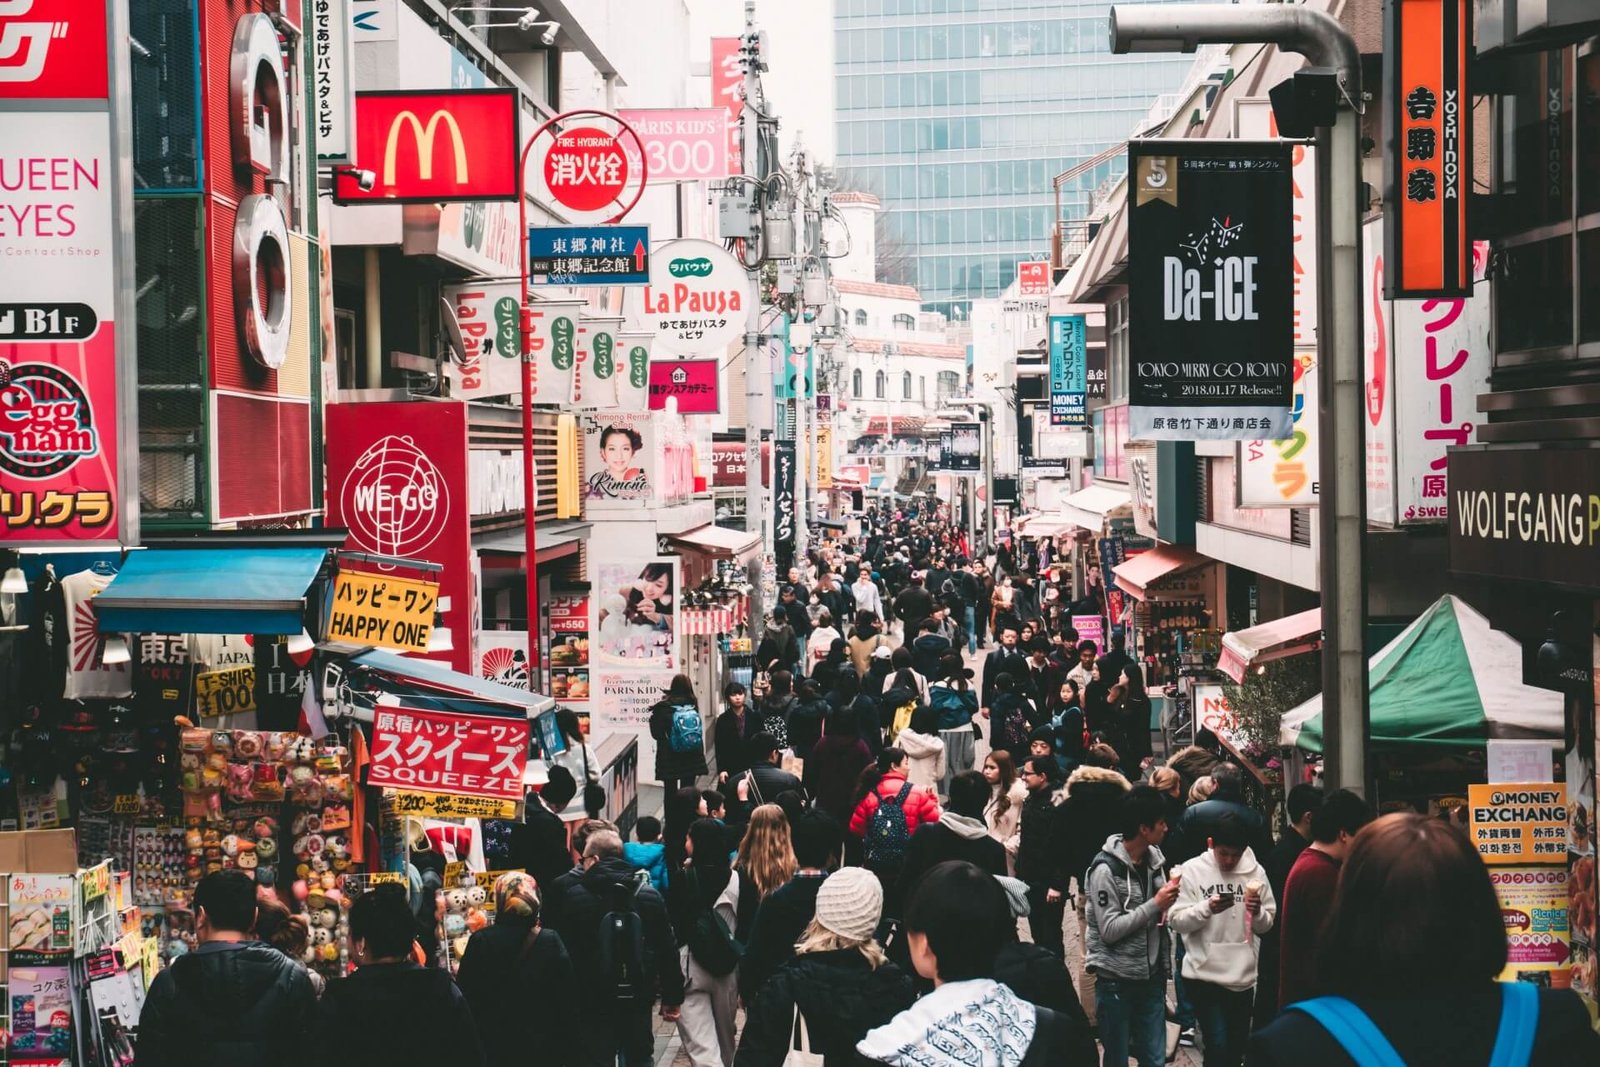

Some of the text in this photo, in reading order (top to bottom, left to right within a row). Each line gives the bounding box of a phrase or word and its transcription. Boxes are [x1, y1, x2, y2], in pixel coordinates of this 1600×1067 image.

[557, 137, 613, 148] FIRE HYDRANT
[1444, 90, 1457, 198] YOSHINOYA
[551, 152, 622, 186] 消火栓
[551, 237, 626, 254] 東郷神社
[551, 257, 630, 274] 東郷記念館
[643, 282, 741, 316] La Pausa
[1087, 369, 1107, 380] 品企
[1181, 384, 1237, 396] 2018.01.17
[1052, 394, 1085, 406] MONEY
[1052, 406, 1085, 414] EXCHANGE
[1152, 417, 1272, 430] 原宿竹下通り商店会
[1456, 489, 1583, 546] WOLFGANG
[337, 582, 434, 615] ハッピーワン
[330, 611, 429, 647] HAPPY ONE
[604, 686, 635, 695] PARIS
[376, 712, 527, 744] 原宿ハッピーワン
[373, 733, 525, 778] スクイーズ
[371, 764, 522, 793] SQUEEZE
[1505, 791, 1560, 804] MONEY
